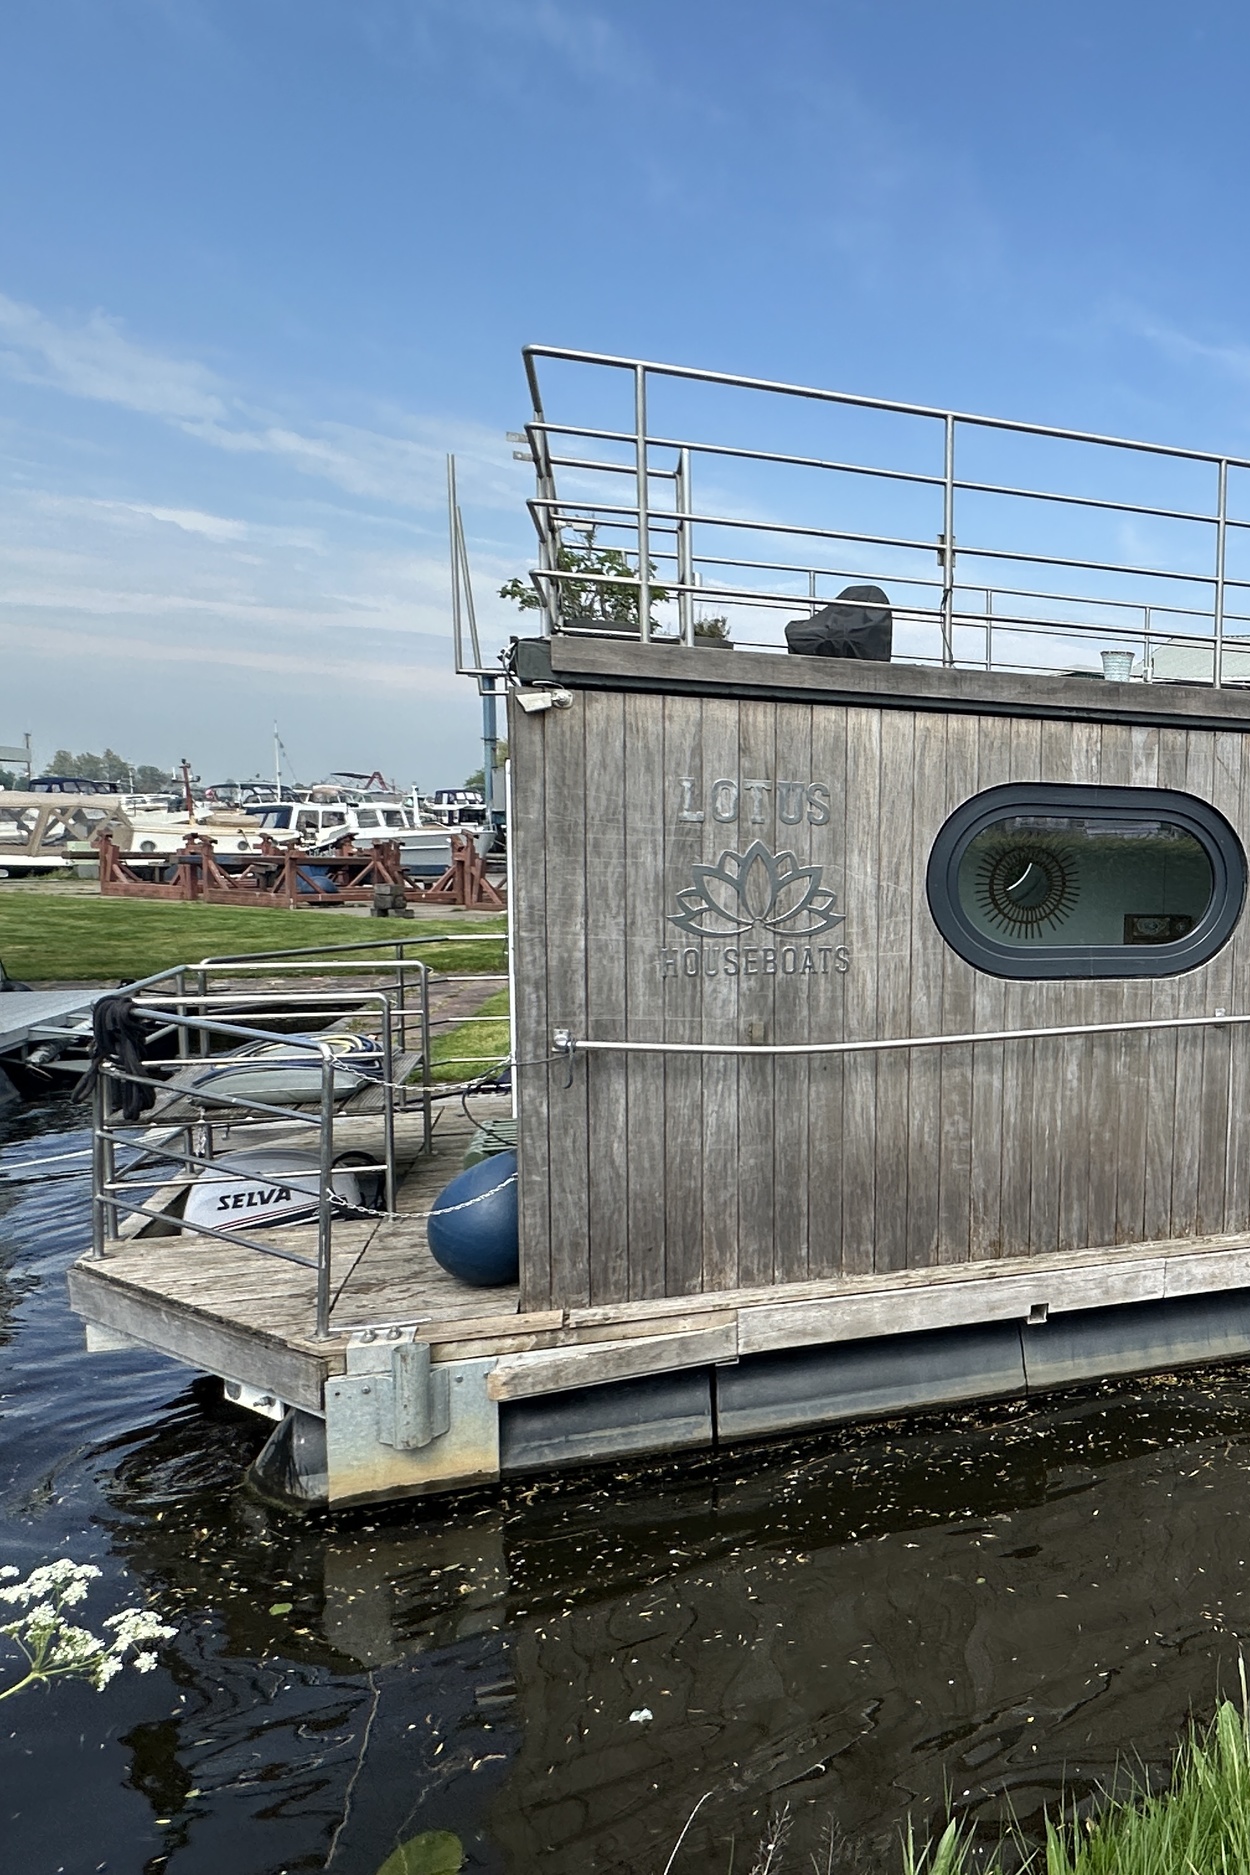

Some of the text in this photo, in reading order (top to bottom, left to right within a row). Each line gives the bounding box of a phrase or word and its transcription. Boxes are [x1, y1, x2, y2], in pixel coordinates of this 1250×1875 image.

[679, 777, 830, 825] LOTUS
[661, 945, 850, 977] HOUSEBOATS
[217, 1187, 291, 1210] SELVA
